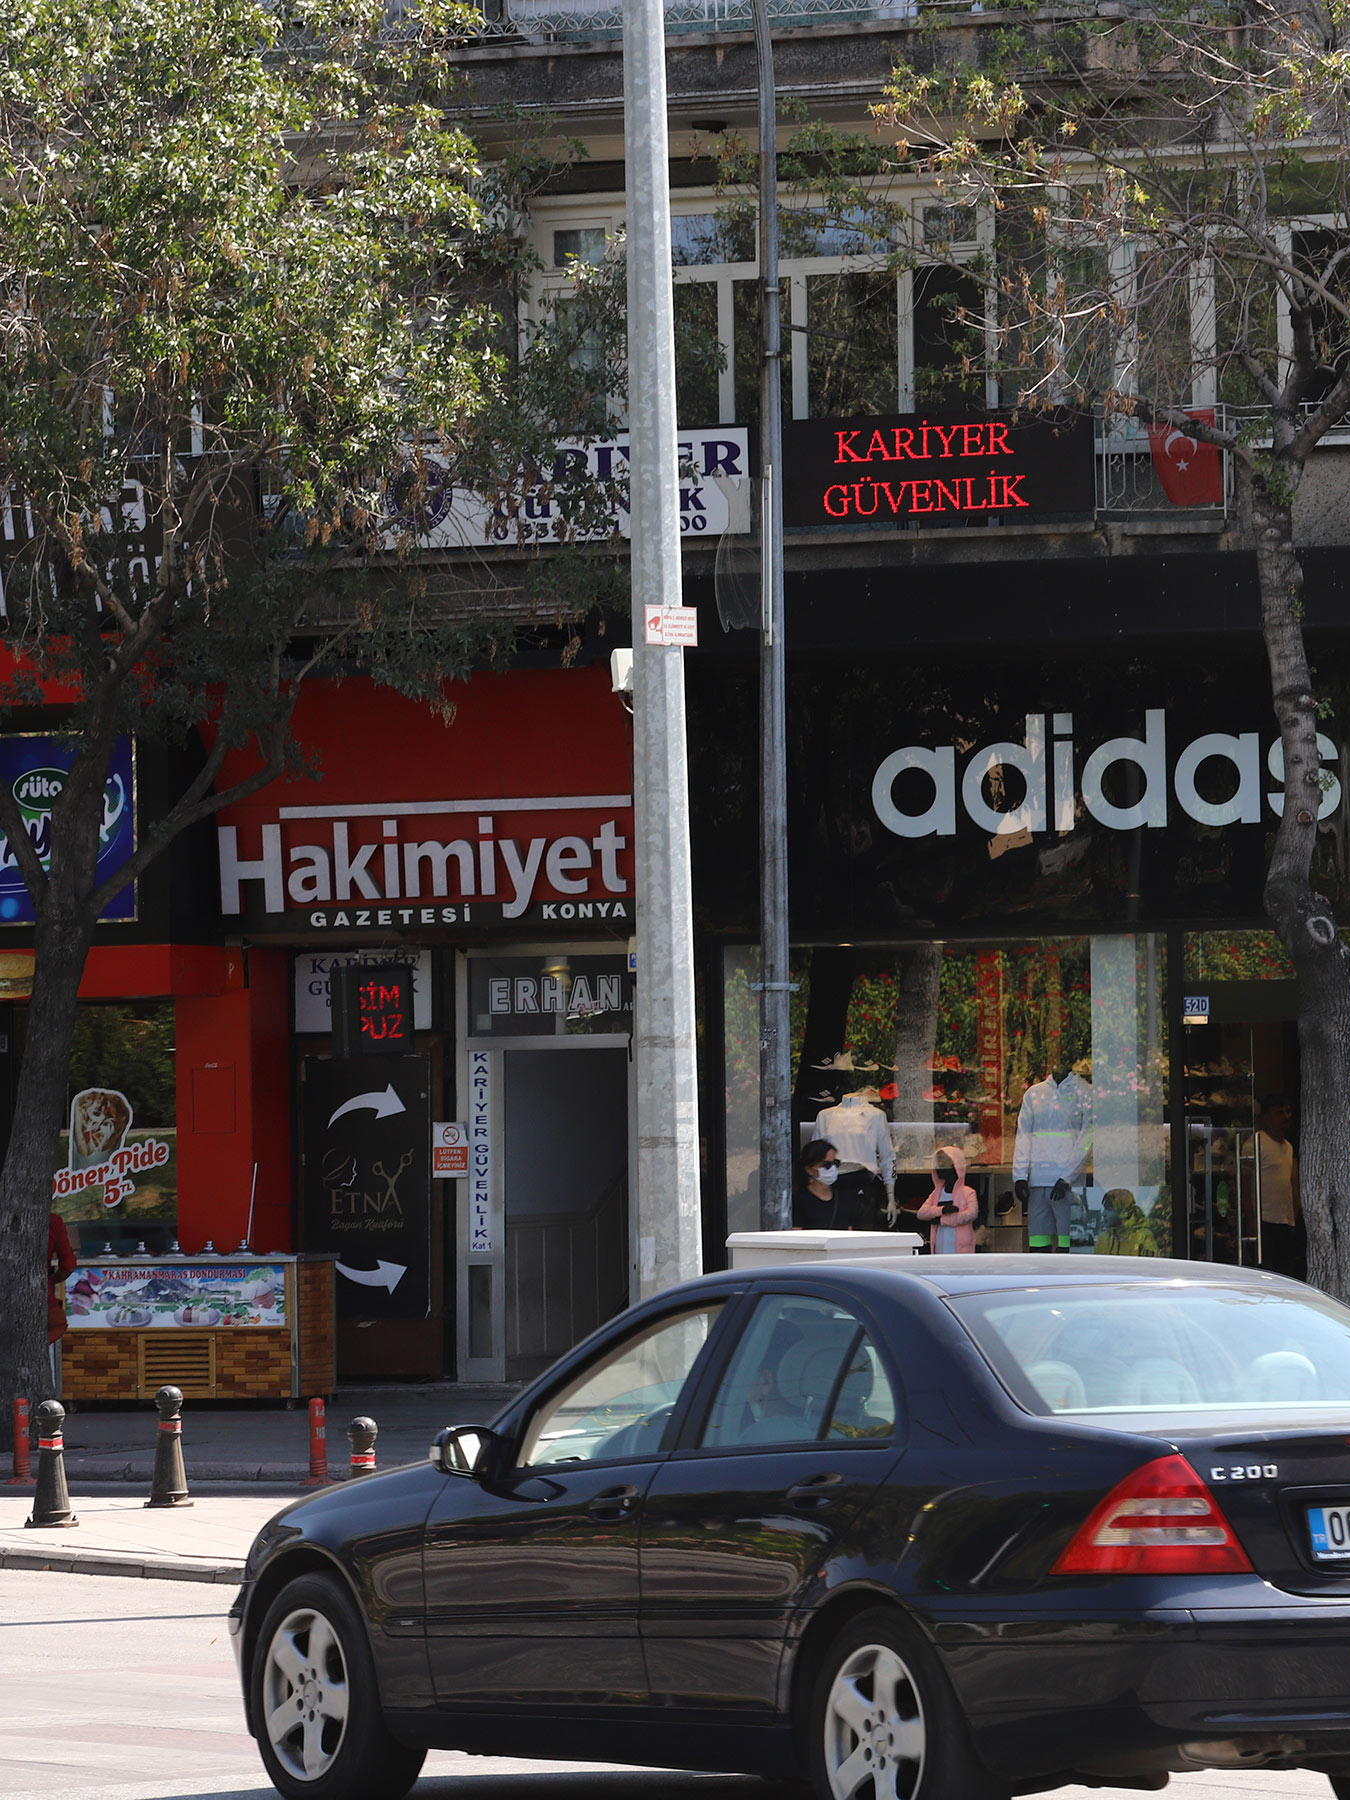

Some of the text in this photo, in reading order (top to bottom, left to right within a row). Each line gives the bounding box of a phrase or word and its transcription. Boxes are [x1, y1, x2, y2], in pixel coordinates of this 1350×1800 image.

[833, 419, 1014, 463] KARİYER
[823, 470, 1030, 518] GÜVENLİK
[871, 708, 1342, 838] adidas
[217, 816, 628, 920] Hakimiyet
[309, 901, 628, 928] GAZETESİ KONYA
[488, 974, 622, 1015] ERHAN
[473, 1052, 489, 1137] KARİYER
[112, 1141, 168, 1174] Pide
[474, 1144, 490, 1238] GÜVENLİK
[330, 1218, 362, 1232] Bayan
[472, 1241, 486, 1250] Kat
[1211, 1464, 1279, 1480] C 200
[1312, 1533, 1328, 1545] TR
